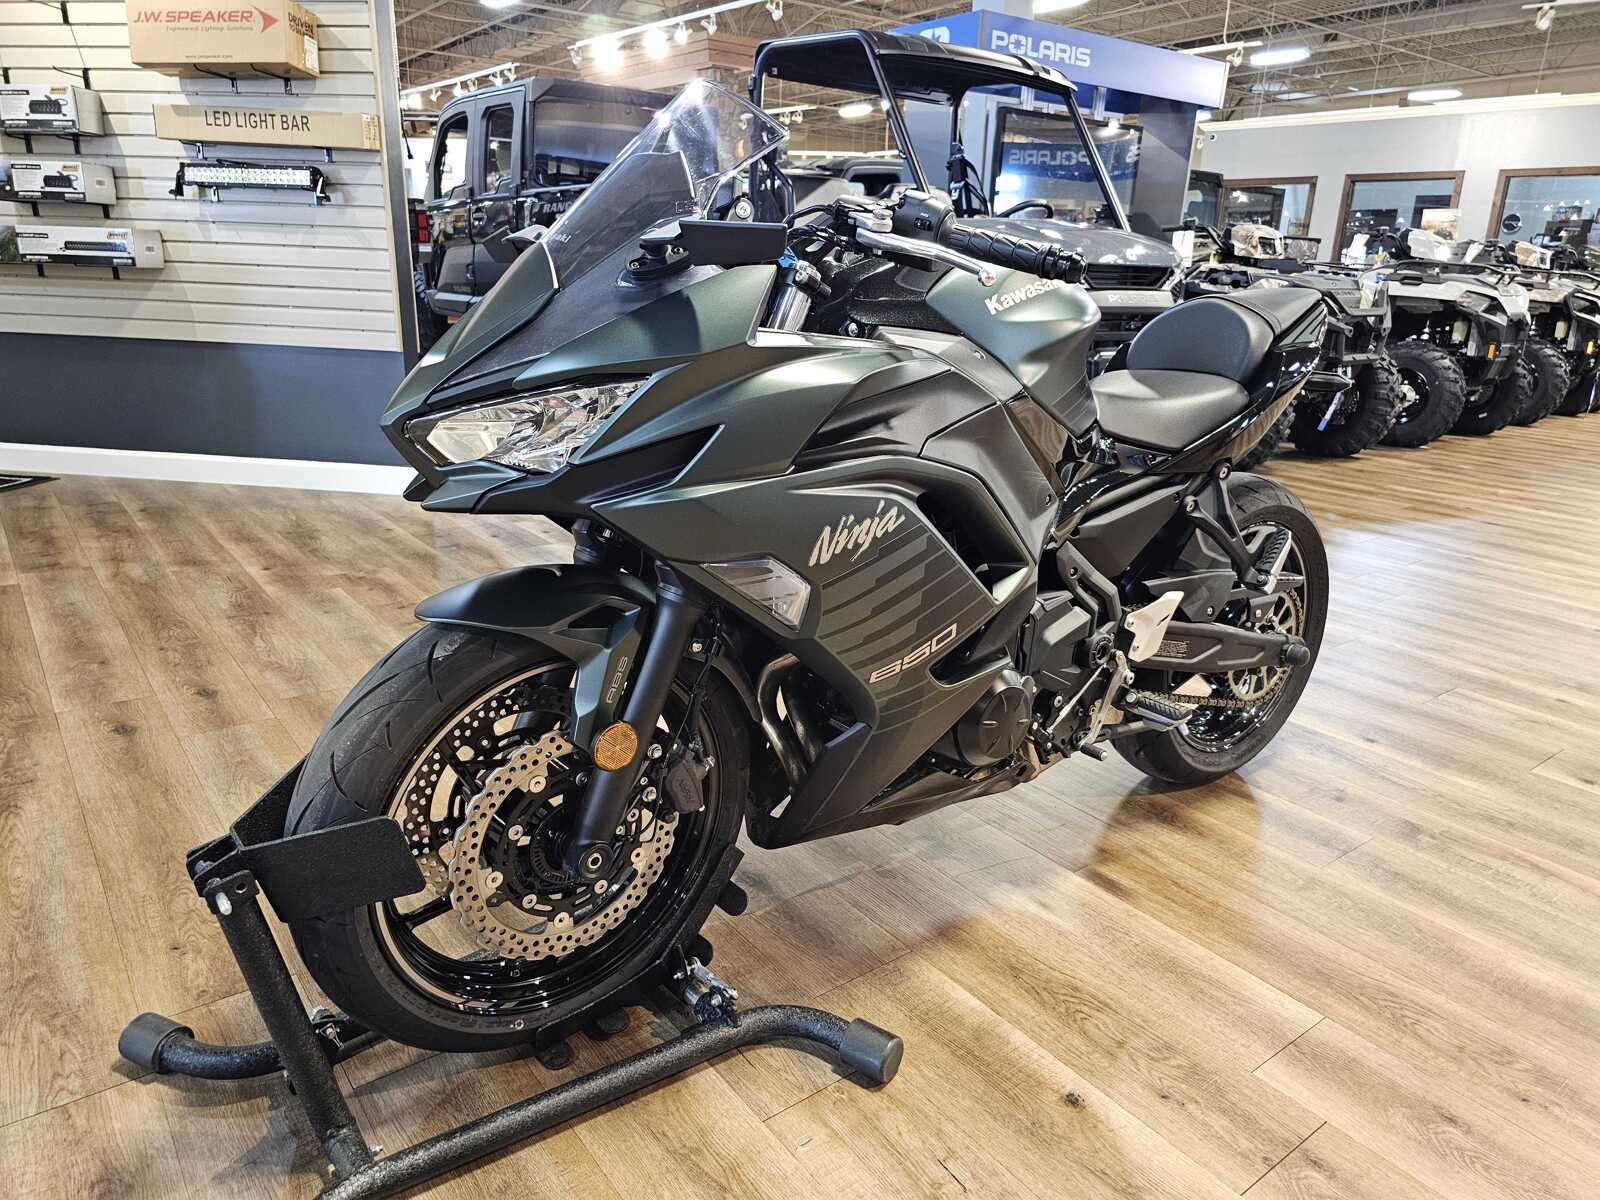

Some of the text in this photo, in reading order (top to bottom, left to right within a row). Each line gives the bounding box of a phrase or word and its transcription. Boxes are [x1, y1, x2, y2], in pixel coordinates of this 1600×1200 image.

[133, 10, 253, 23] J.W. SPEAKER
[991, 30, 1091, 67] POLARIS
[204, 109, 310, 132] LED LIGHT BAR
[808, 500, 906, 567] Ninja
[868, 622, 957, 684] 650
[606, 656, 628, 704] ABS
